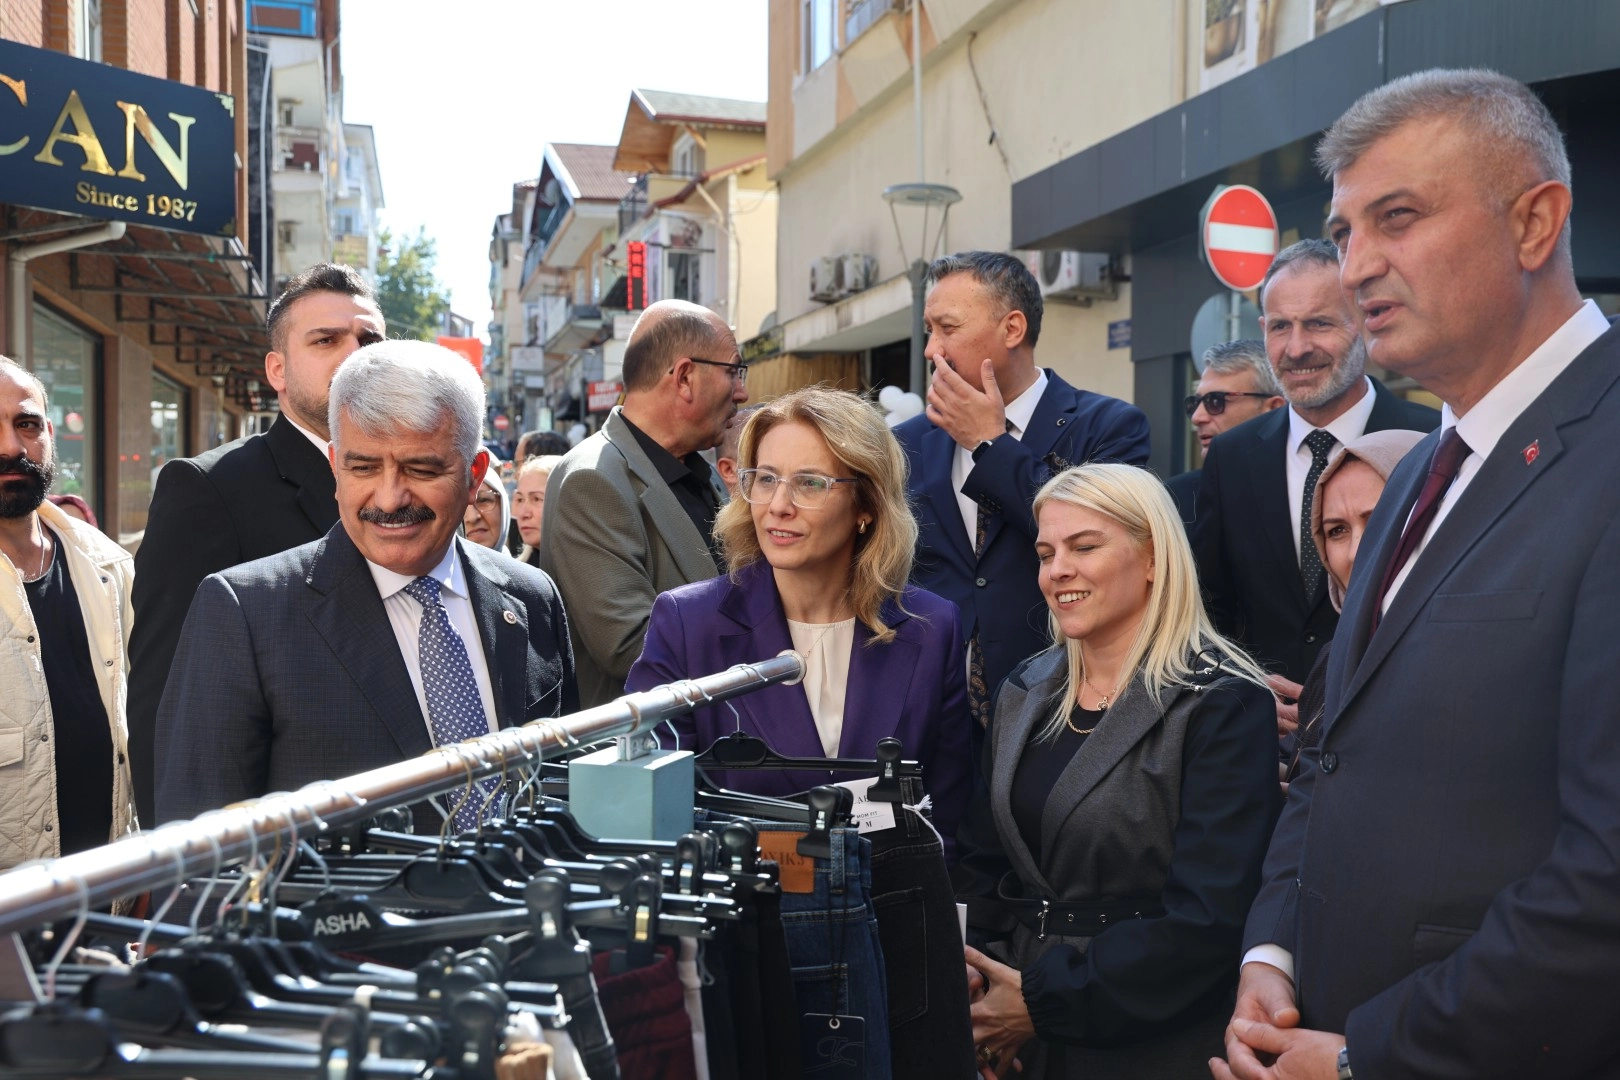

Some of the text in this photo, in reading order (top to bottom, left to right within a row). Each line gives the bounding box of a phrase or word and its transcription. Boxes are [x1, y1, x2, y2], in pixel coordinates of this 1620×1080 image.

[76, 181, 198, 222] Since 1987
[313, 911, 371, 937] ASHA
